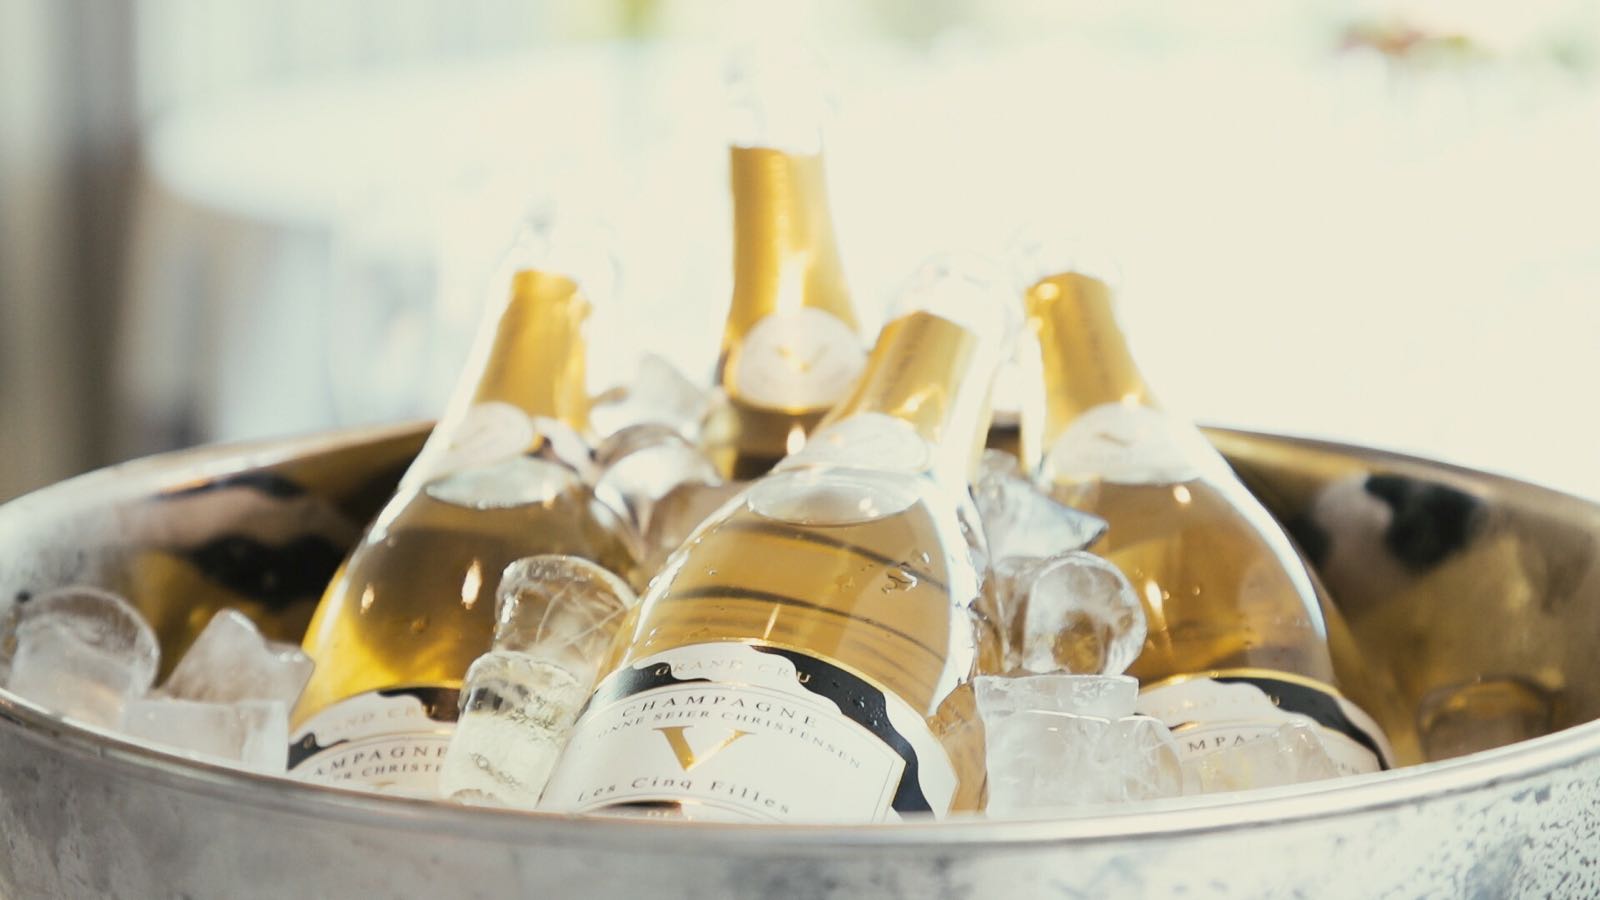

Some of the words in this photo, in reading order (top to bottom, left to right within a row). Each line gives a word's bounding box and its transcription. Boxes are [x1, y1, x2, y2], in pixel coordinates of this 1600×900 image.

[654, 659, 744, 677] GRAND
[757, 663, 812, 684] CRU
[621, 694, 818, 729] CHAMPAGNE
[651, 724, 758, 773] V
[652, 710, 710, 722] SEIER
[720, 711, 861, 770] CHRISTENSEN
[314, 746, 449, 777] AMPAGNE
[577, 784, 617, 803] Les
[630, 776, 693, 791] Cinq
[709, 780, 790, 815] Filles
